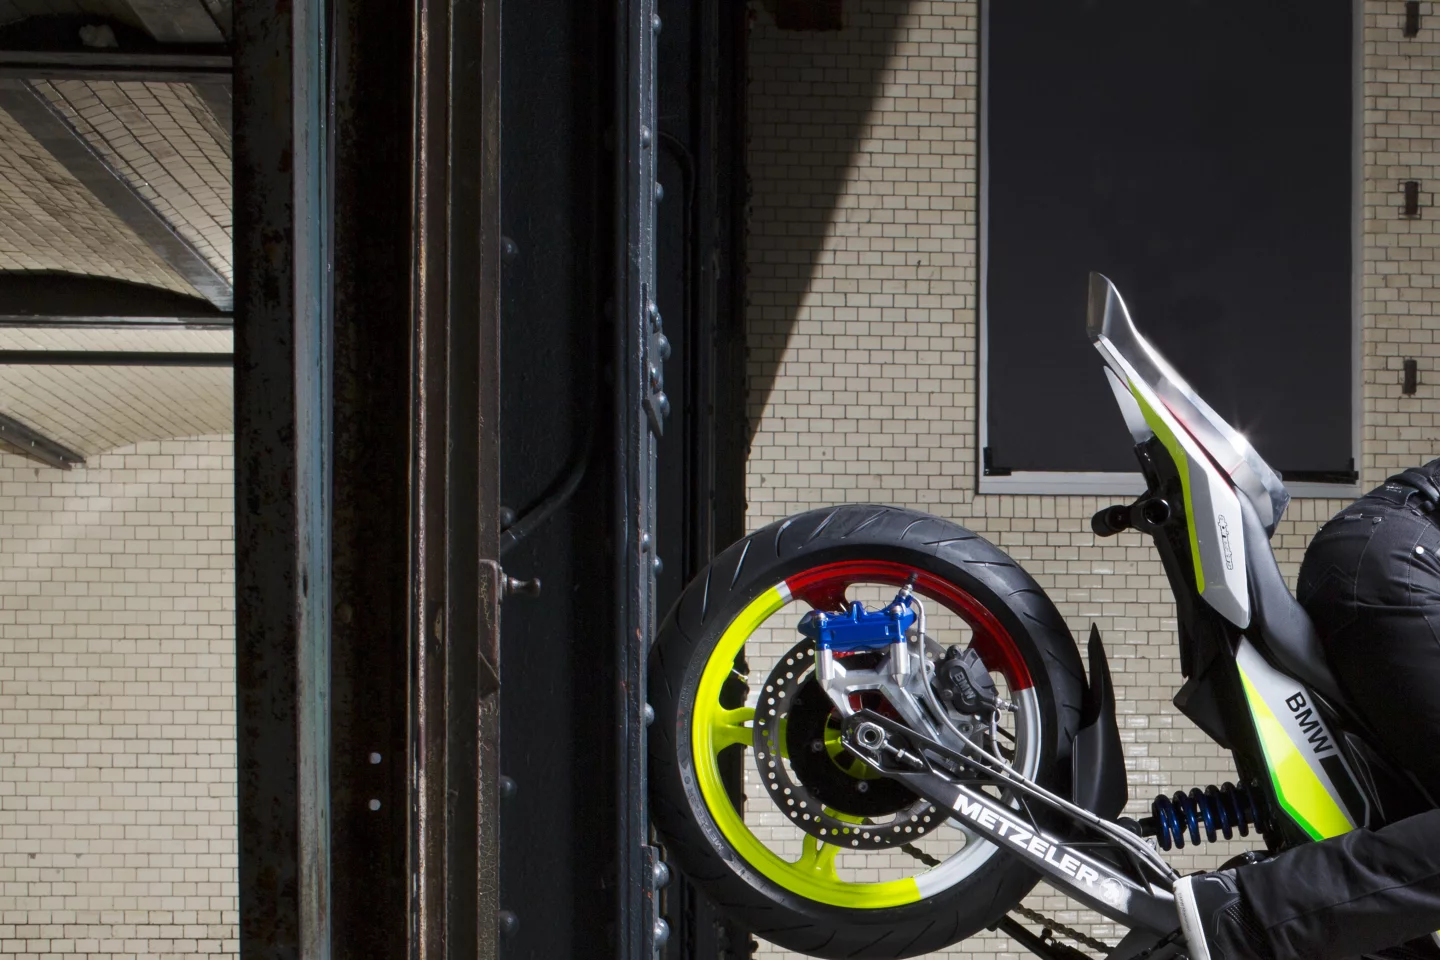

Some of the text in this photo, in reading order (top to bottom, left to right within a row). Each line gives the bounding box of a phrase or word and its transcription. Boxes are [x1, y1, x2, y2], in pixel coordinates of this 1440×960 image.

[954, 671, 976, 700] BMW
[1285, 691, 1333, 754] BMW
[953, 793, 1099, 889] METZELER
